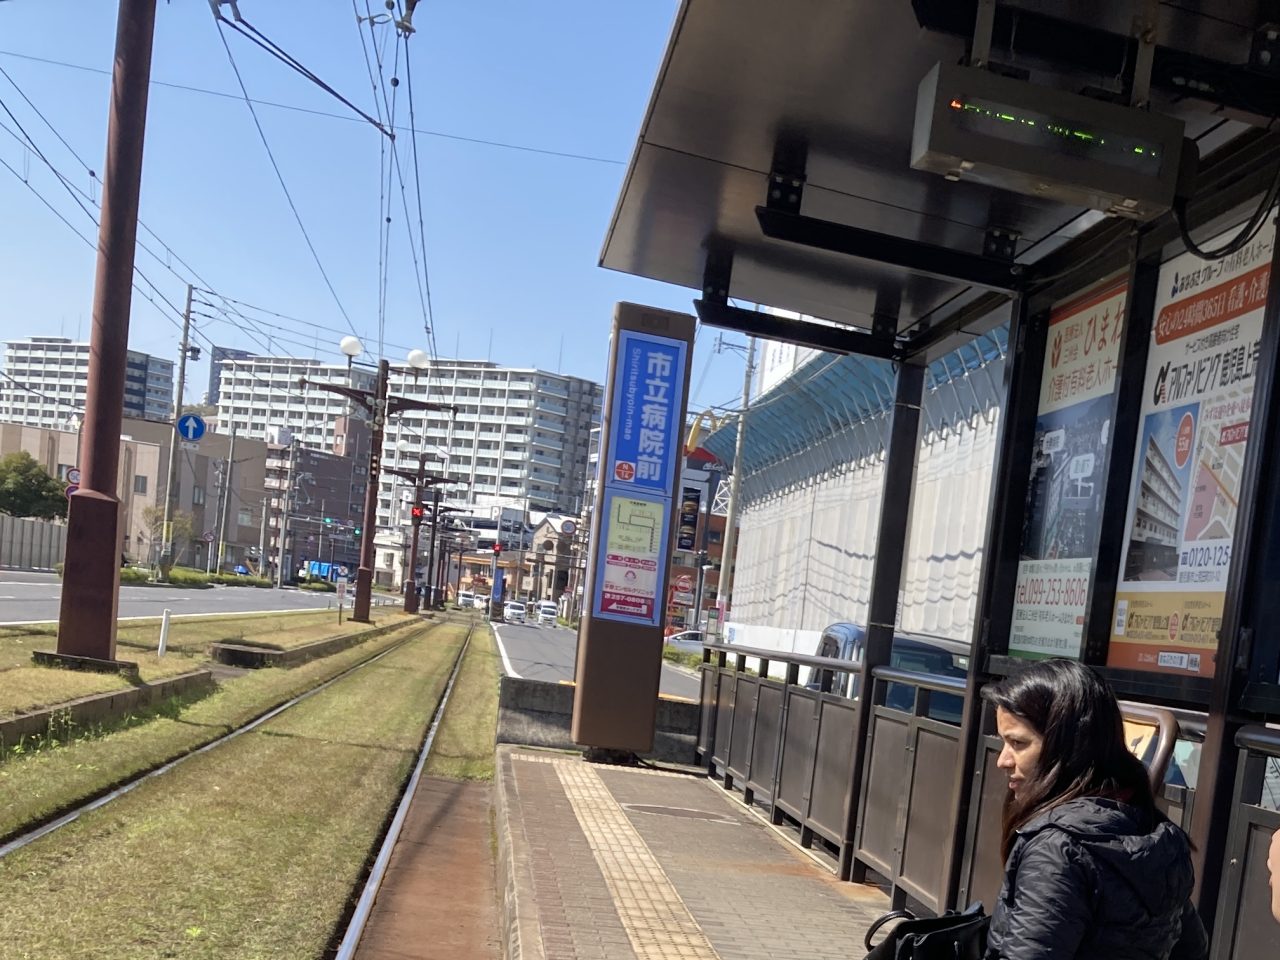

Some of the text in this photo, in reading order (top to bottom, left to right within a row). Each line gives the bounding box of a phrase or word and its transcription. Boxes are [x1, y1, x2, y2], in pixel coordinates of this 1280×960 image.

[624, 347, 641, 440] Shiritsubyoin-mae
[636, 352, 673, 481] 市立病院前
[1016, 578, 1088, 606] tel.099-253-8606
